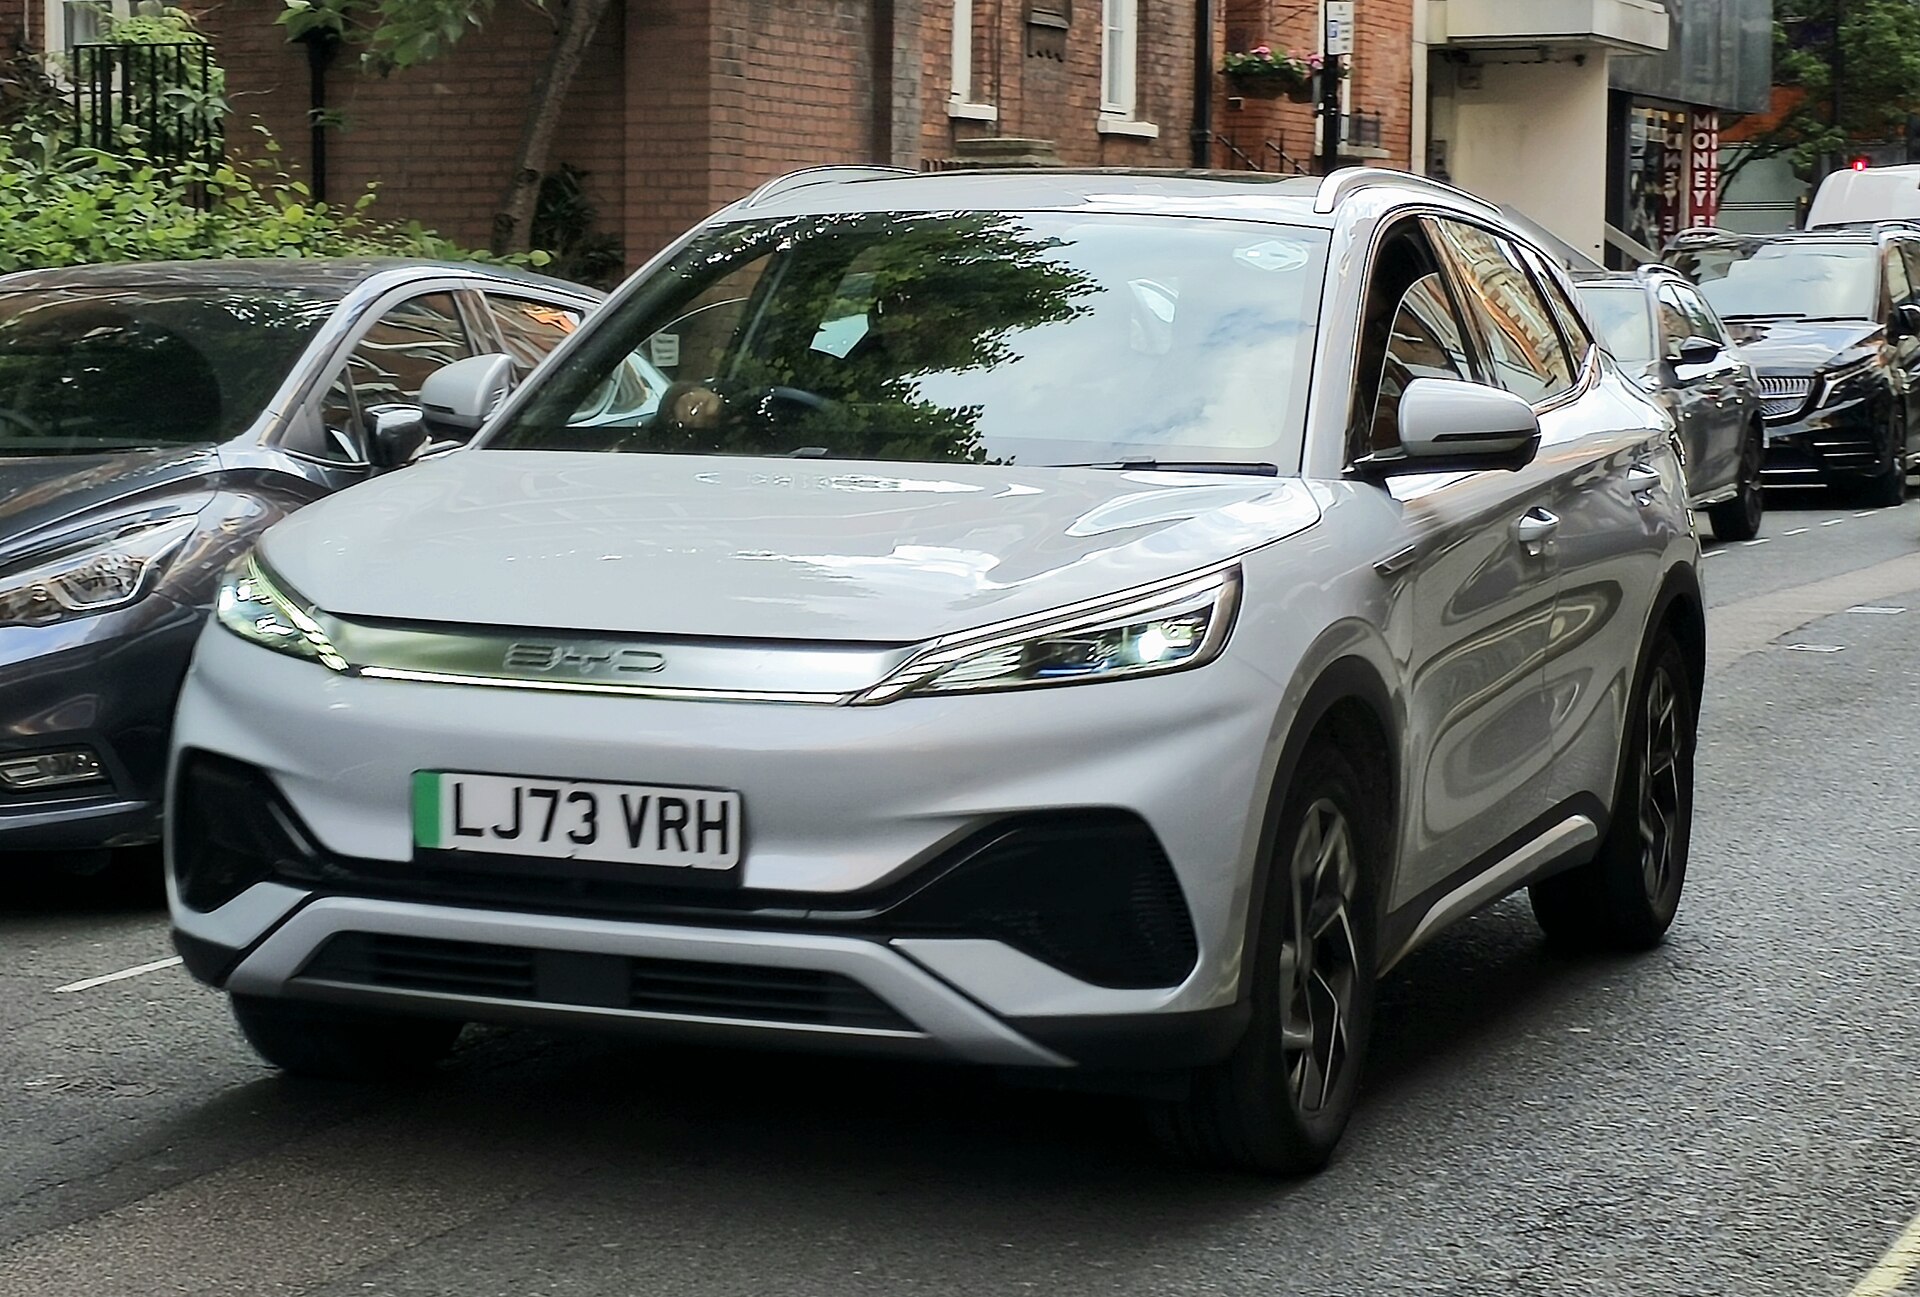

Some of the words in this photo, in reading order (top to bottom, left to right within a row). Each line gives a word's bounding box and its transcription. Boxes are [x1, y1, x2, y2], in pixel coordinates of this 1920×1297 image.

[1692, 113, 1711, 208] MONEY
[502, 642, 667, 674] BYD
[454, 782, 597, 846] LJ73
[620, 793, 729, 855] VRH
